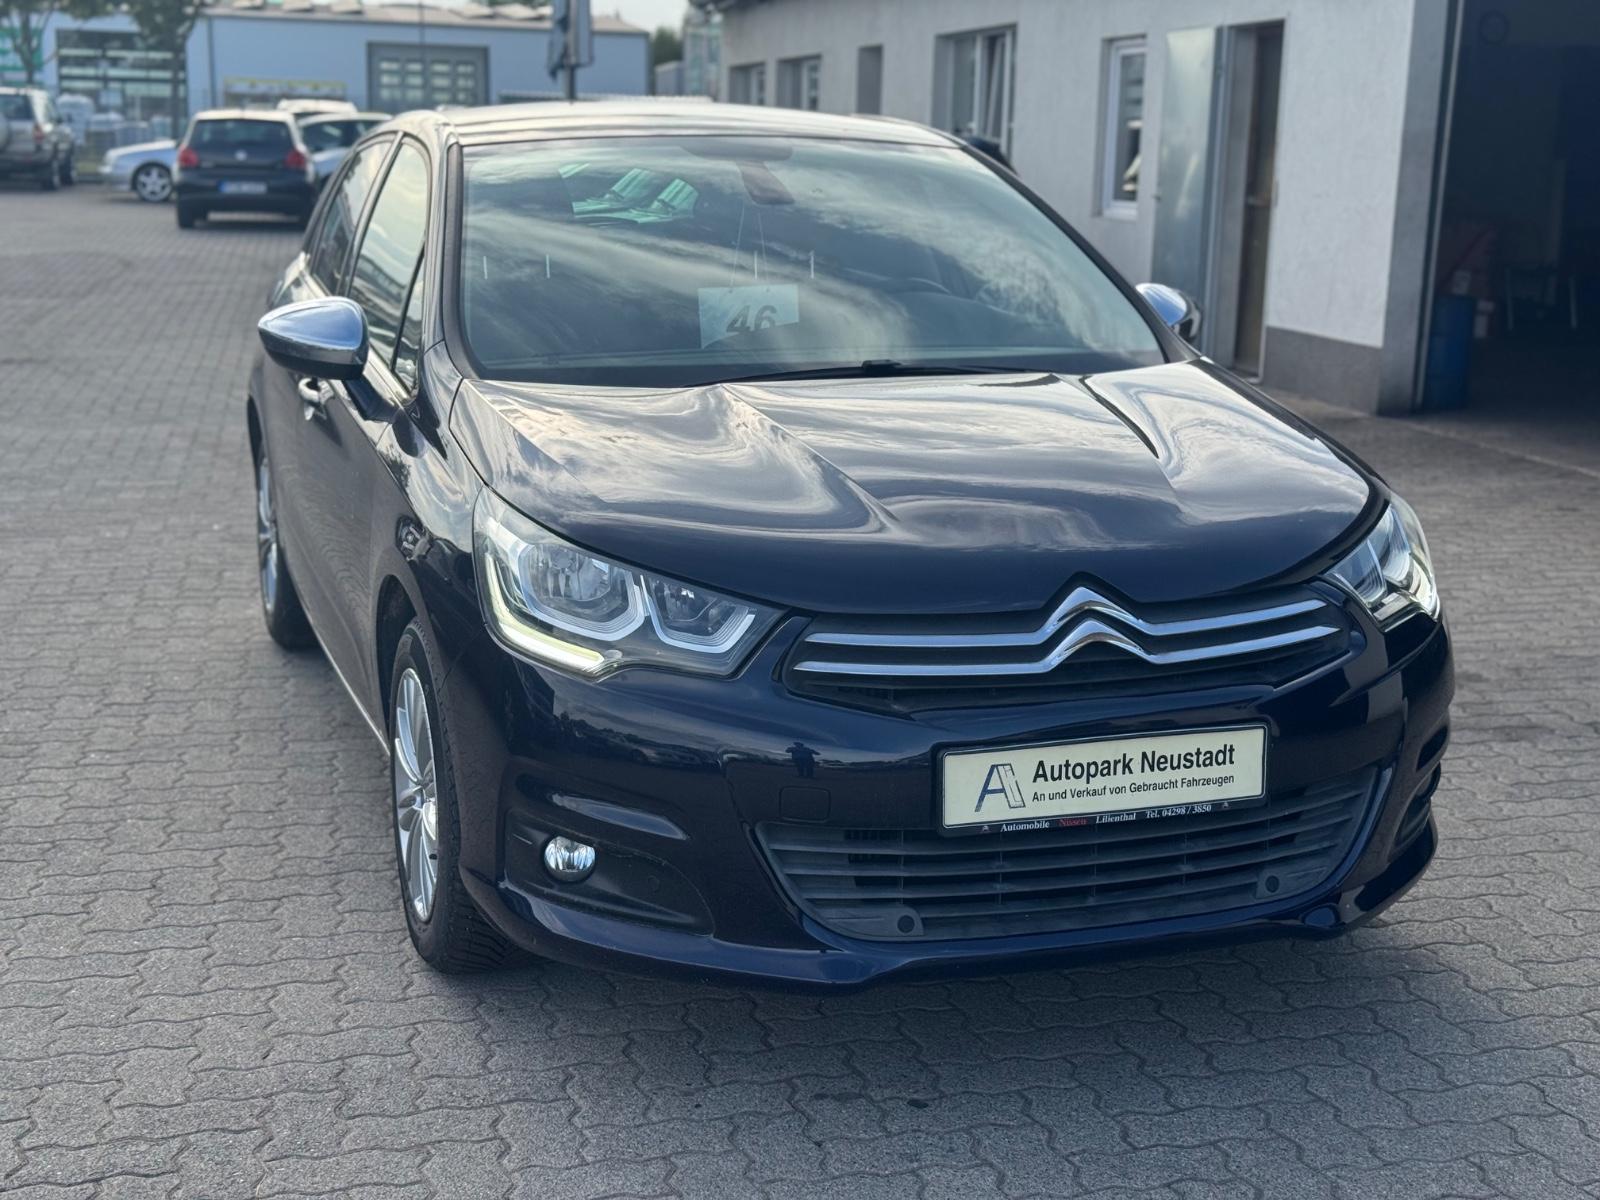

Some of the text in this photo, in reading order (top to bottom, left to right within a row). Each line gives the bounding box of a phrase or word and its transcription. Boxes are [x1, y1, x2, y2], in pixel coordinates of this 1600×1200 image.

[1032, 743, 1235, 784] Autopark Neustadt
[1032, 775, 1235, 802] An und Verkauf von Gebraucht Fahrzeugen
[1000, 819, 1050, 832] Automobile
[1095, 812, 1137, 824] Lilienthal
[1145, 809, 1161, 819] Tel.
